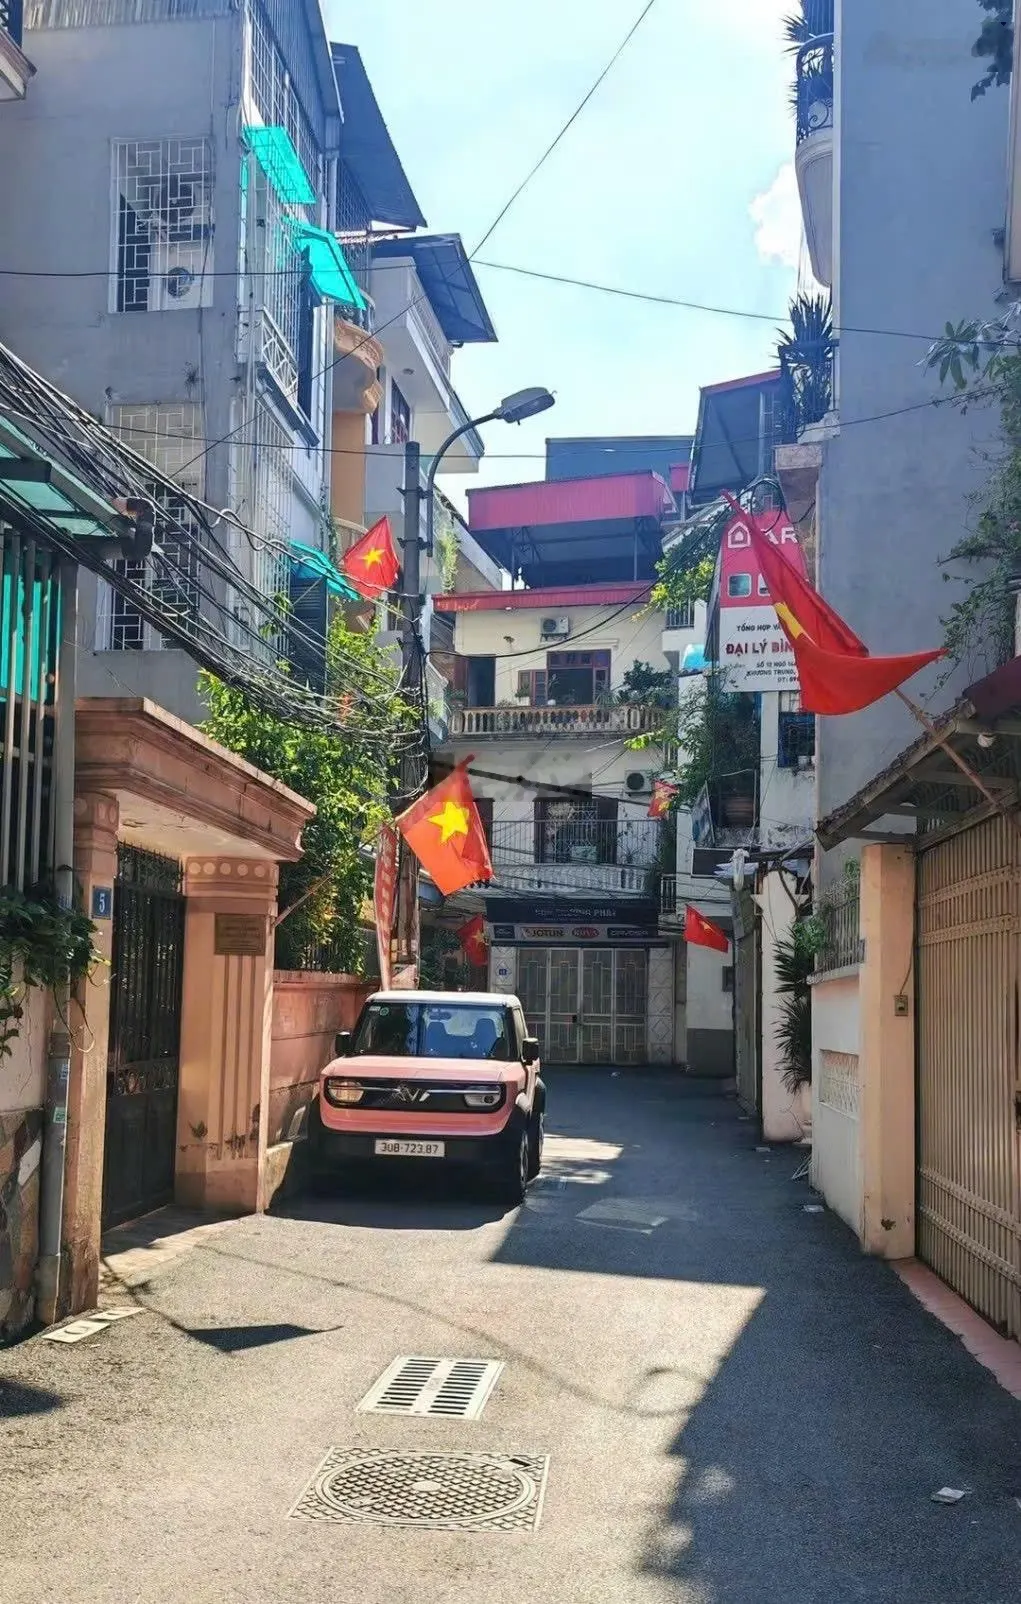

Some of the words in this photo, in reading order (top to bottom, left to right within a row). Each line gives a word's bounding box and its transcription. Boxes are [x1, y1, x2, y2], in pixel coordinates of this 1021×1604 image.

[736, 622, 756, 632] TỔNG
[726, 642, 748, 657] ĐẠI
[752, 638, 768, 654] LÝ
[99, 893, 106, 913] 5
